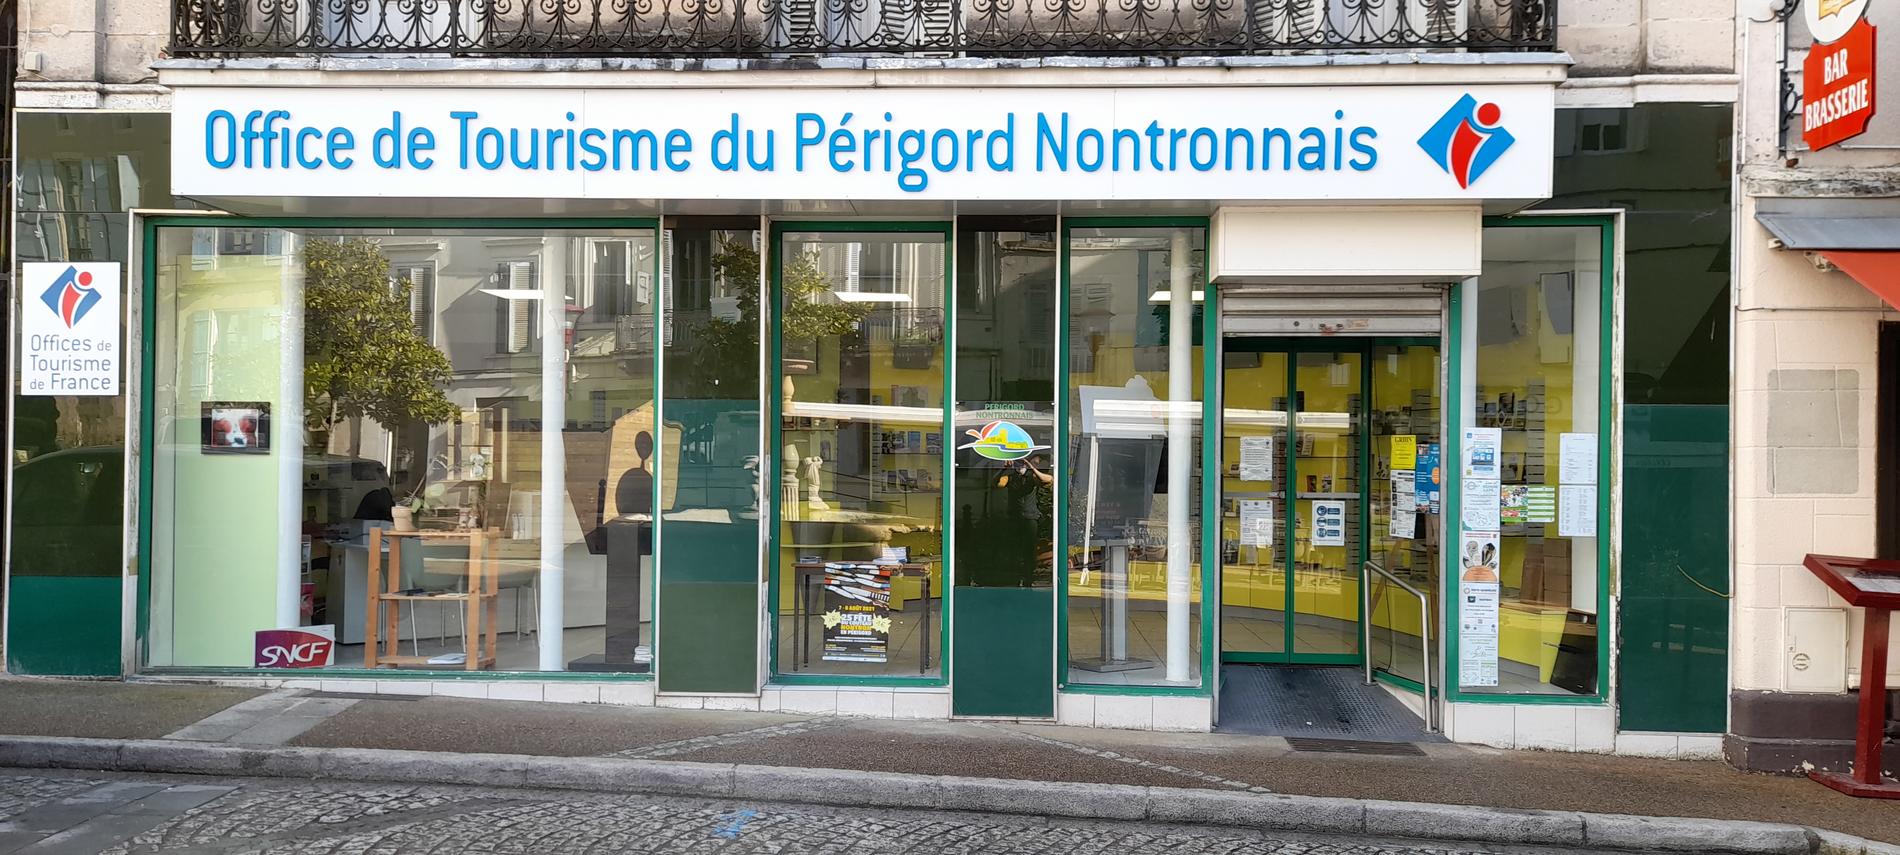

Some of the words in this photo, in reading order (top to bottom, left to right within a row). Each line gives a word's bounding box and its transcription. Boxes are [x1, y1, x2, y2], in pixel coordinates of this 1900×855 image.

[1824, 48, 1848, 85] BAR
[1804, 78, 1868, 132] BRASSERIE
[205, 109, 355, 170] Office
[372, 111, 436, 170] de
[450, 111, 693, 172] Tourisme
[711, 112, 775, 172] du
[795, 111, 1015, 193] Périgord
[1036, 109, 1378, 173] Nontronnais
[31, 334, 92, 352] Offices
[97, 340, 112, 351] de
[30, 354, 111, 372] Tourisme
[30, 378, 45, 390] de
[51, 373, 111, 390] France
[976, 411, 1034, 419] NONTRONNAIS
[258, 641, 329, 667] SNCF
